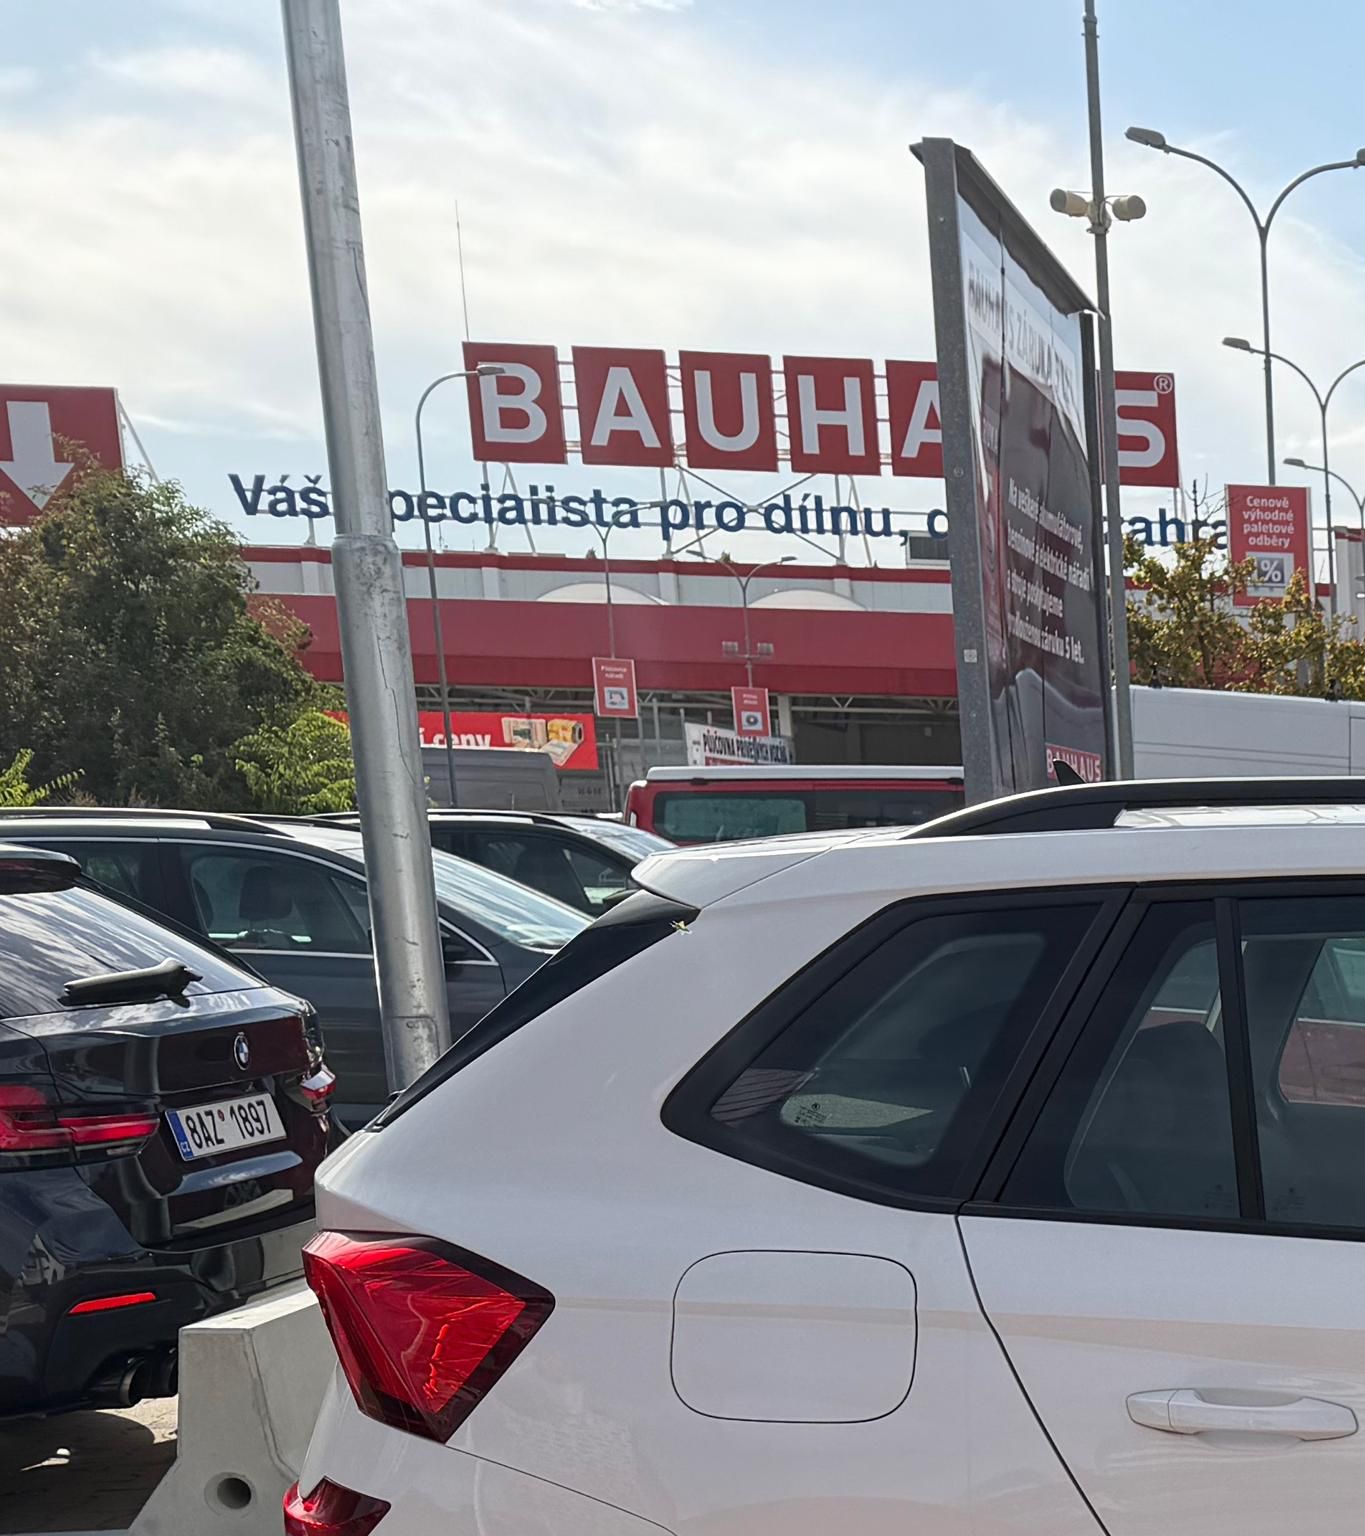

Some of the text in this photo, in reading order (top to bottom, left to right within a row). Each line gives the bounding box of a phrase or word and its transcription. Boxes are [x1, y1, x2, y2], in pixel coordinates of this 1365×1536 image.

[477, 361, 1167, 468] BAUHAS
[228, 474, 330, 519] Váš
[388, 484, 641, 533] pecialista
[660, 499, 746, 541] pro
[764, 494, 909, 546] dílnu,
[1246, 495, 1289, 509] Cenově
[1242, 508, 1294, 524] výhodné
[1243, 521, 1295, 536] paletové
[1248, 535, 1290, 549] odběry
[1065, 636, 1071, 659] 5
[1046, 748, 1101, 782] BHAUS
[185, 1099, 271, 1150] 8AZ 1897
